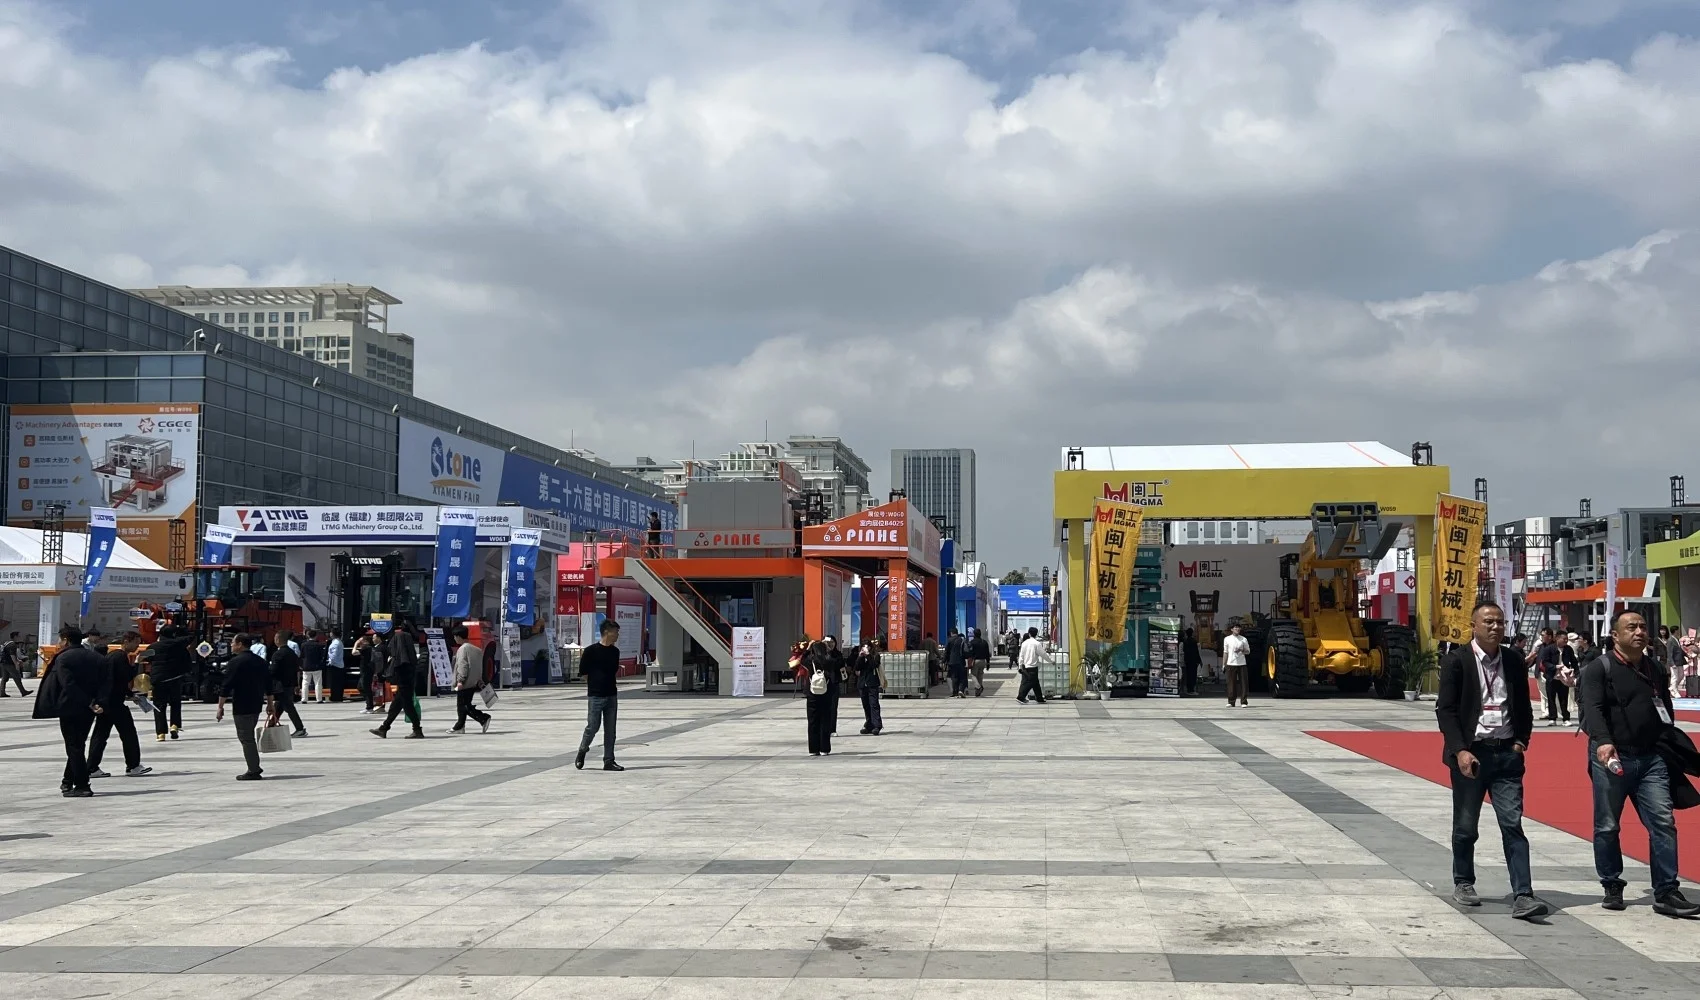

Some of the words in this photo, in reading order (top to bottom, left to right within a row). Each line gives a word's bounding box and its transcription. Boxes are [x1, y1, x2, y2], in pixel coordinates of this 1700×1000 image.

[431, 436, 481, 482] Stone
[432, 486, 462, 501] XIAMEN
[464, 491, 480, 504] FAIR
[1132, 482, 1163, 497] 闽工
[1132, 498, 1163, 506] MGMA
[265, 510, 309, 520] LTMG
[1114, 508, 1138, 522] 闽工
[1460, 504, 1481, 519] 闽工
[272, 522, 308, 531] 临晟集团
[1114, 520, 1136, 528] MGMA
[1458, 516, 1479, 526] MGMA
[714, 534, 761, 546] PINHE
[846, 528, 898, 543] PINHE
[447, 538, 463, 604] 临晟集团
[1099, 528, 1125, 612] 闽工机械
[1200, 561, 1223, 572] 闽工
[1441, 525, 1469, 611] 闽工机械
[516, 556, 527, 614] 临晟集团
